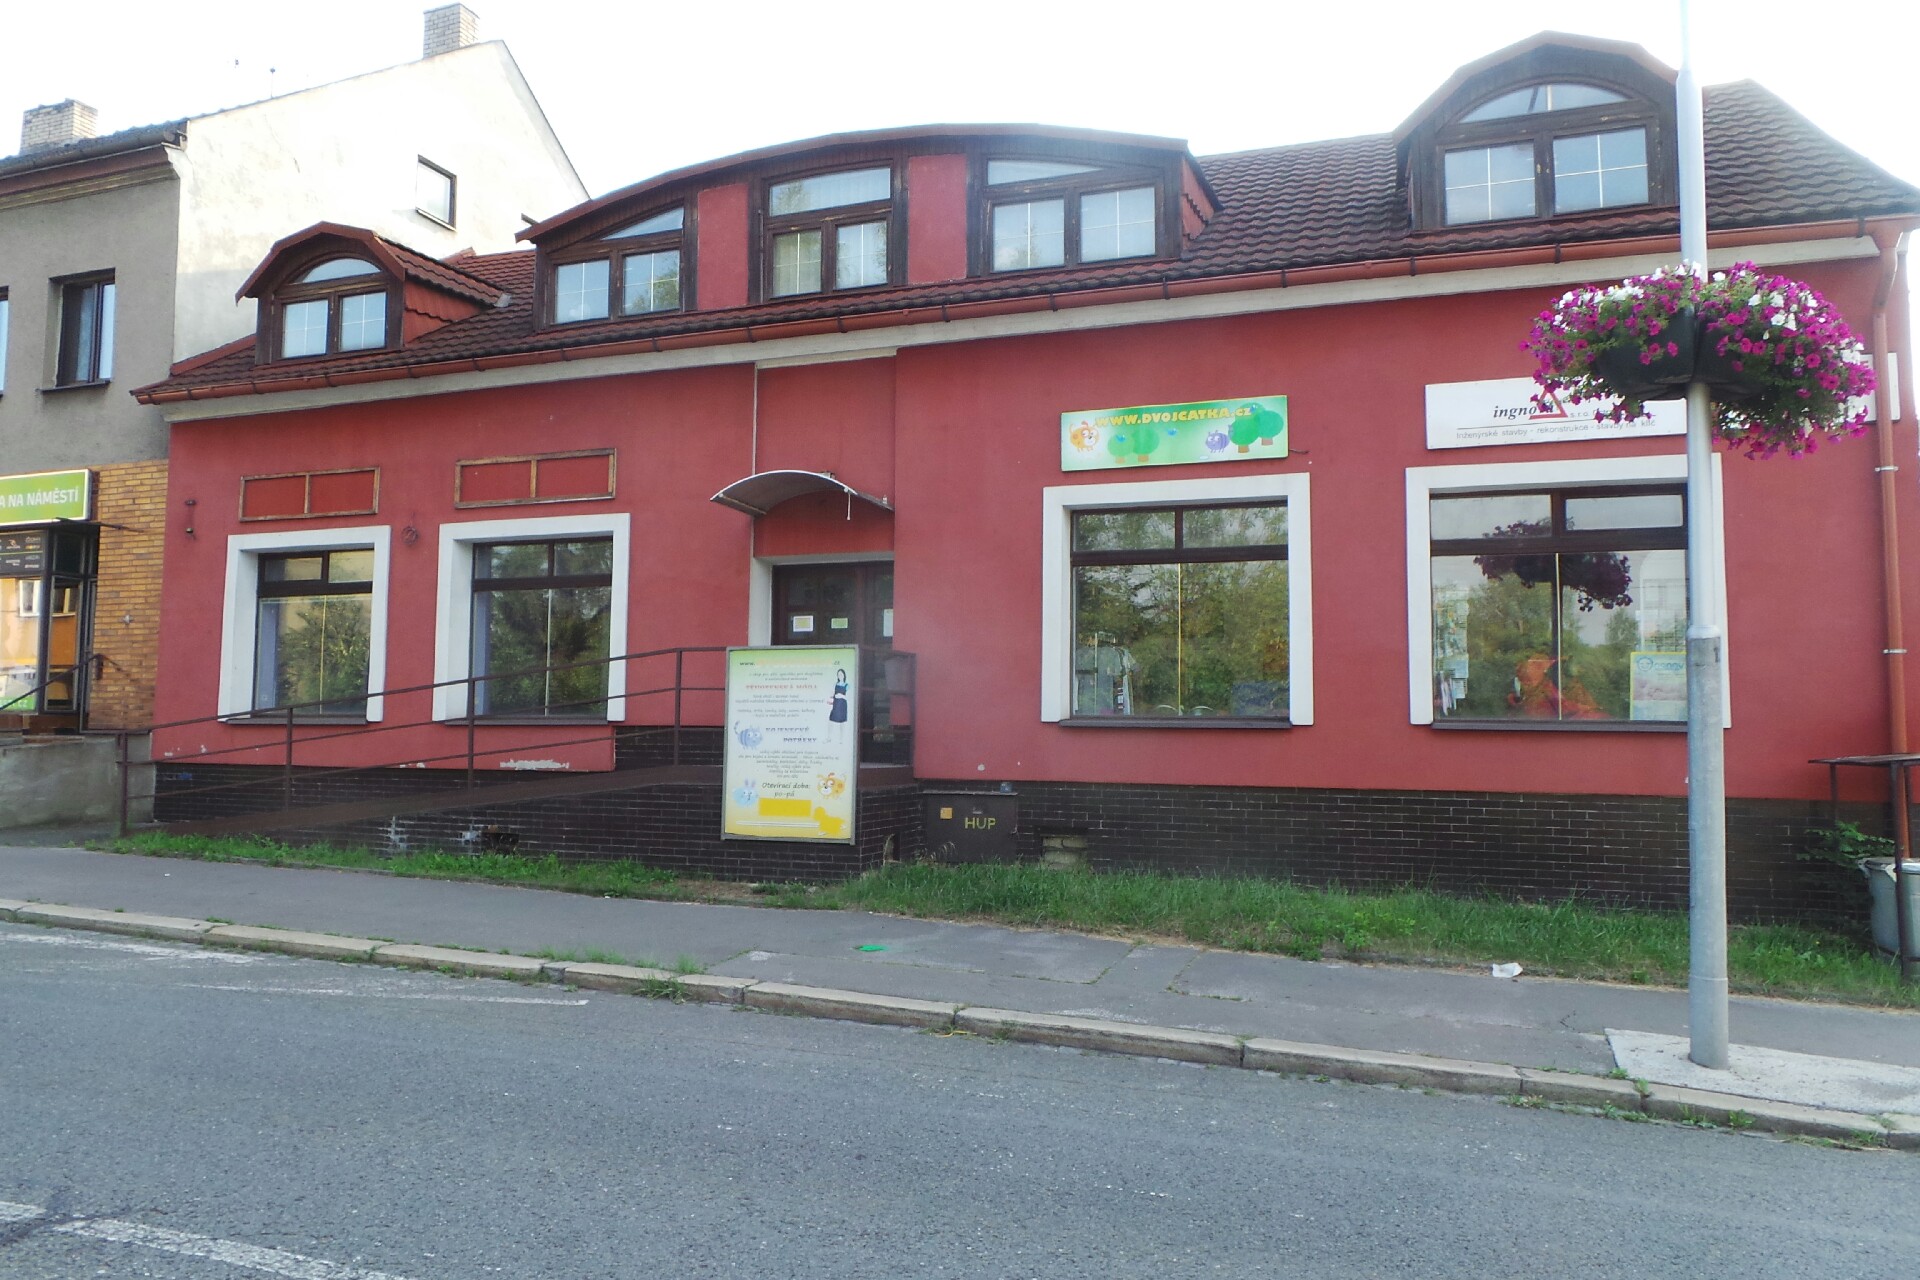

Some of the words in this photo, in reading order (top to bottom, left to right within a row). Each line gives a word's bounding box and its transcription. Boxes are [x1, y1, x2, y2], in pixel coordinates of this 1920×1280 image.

[1502, 428, 1528, 437] stavby
[1537, 424, 1589, 434] rekonstrukce
[1596, 422, 1623, 431] stavby
[8, 494, 24, 508] NA
[26, 486, 79, 505] NÁMĚSTÍ
[964, 817, 996, 830] HUP
